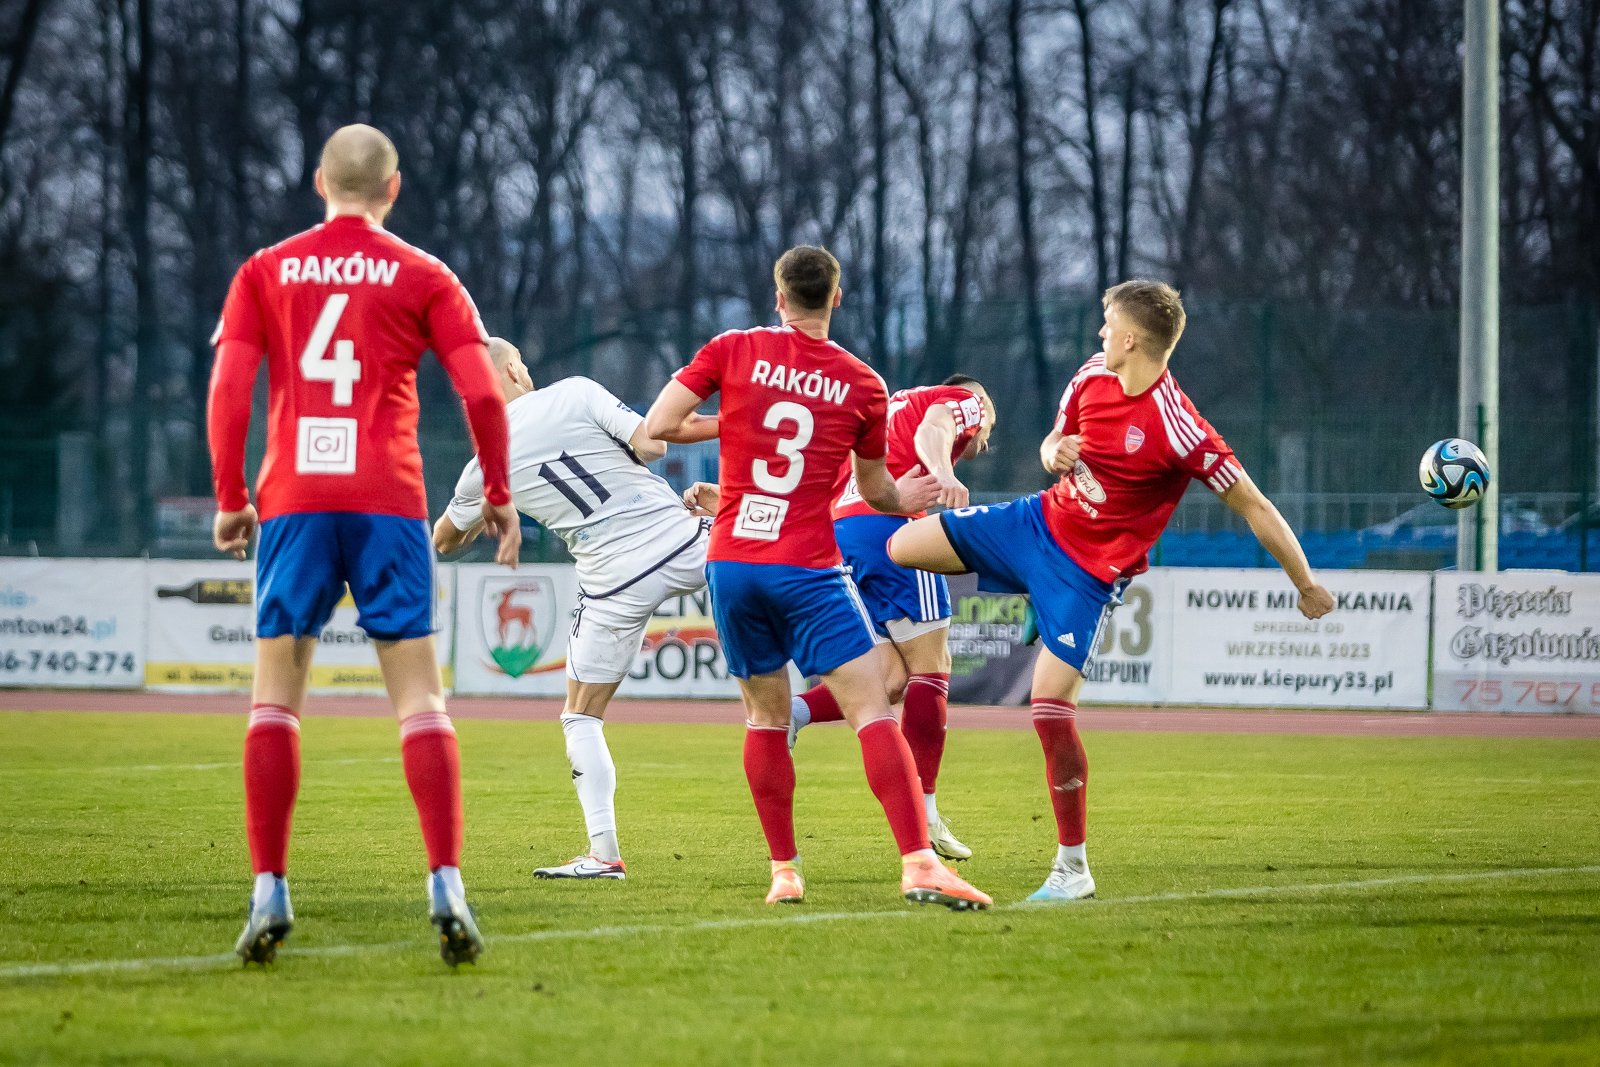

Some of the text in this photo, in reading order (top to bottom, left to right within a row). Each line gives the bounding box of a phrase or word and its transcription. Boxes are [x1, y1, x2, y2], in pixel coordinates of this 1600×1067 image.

[280, 251, 399, 286] RAKÓW
[298, 293, 361, 406] 4
[751, 359, 850, 405] RAKÓW
[752, 401, 814, 495] 3
[538, 450, 612, 519] 11
[1186, 588, 1414, 611] NOWE MIKANIA
[1456, 582, 1574, 619] Pizzeria
[0, 650, 136, 673] 6-740-274
[1225, 638, 1372, 659] WRZEŚNIA 2023
[1204, 669, 1394, 695] www.kiepury33.pl
[1454, 680, 1503, 706] 75
[1511, 681, 1583, 707] 767
